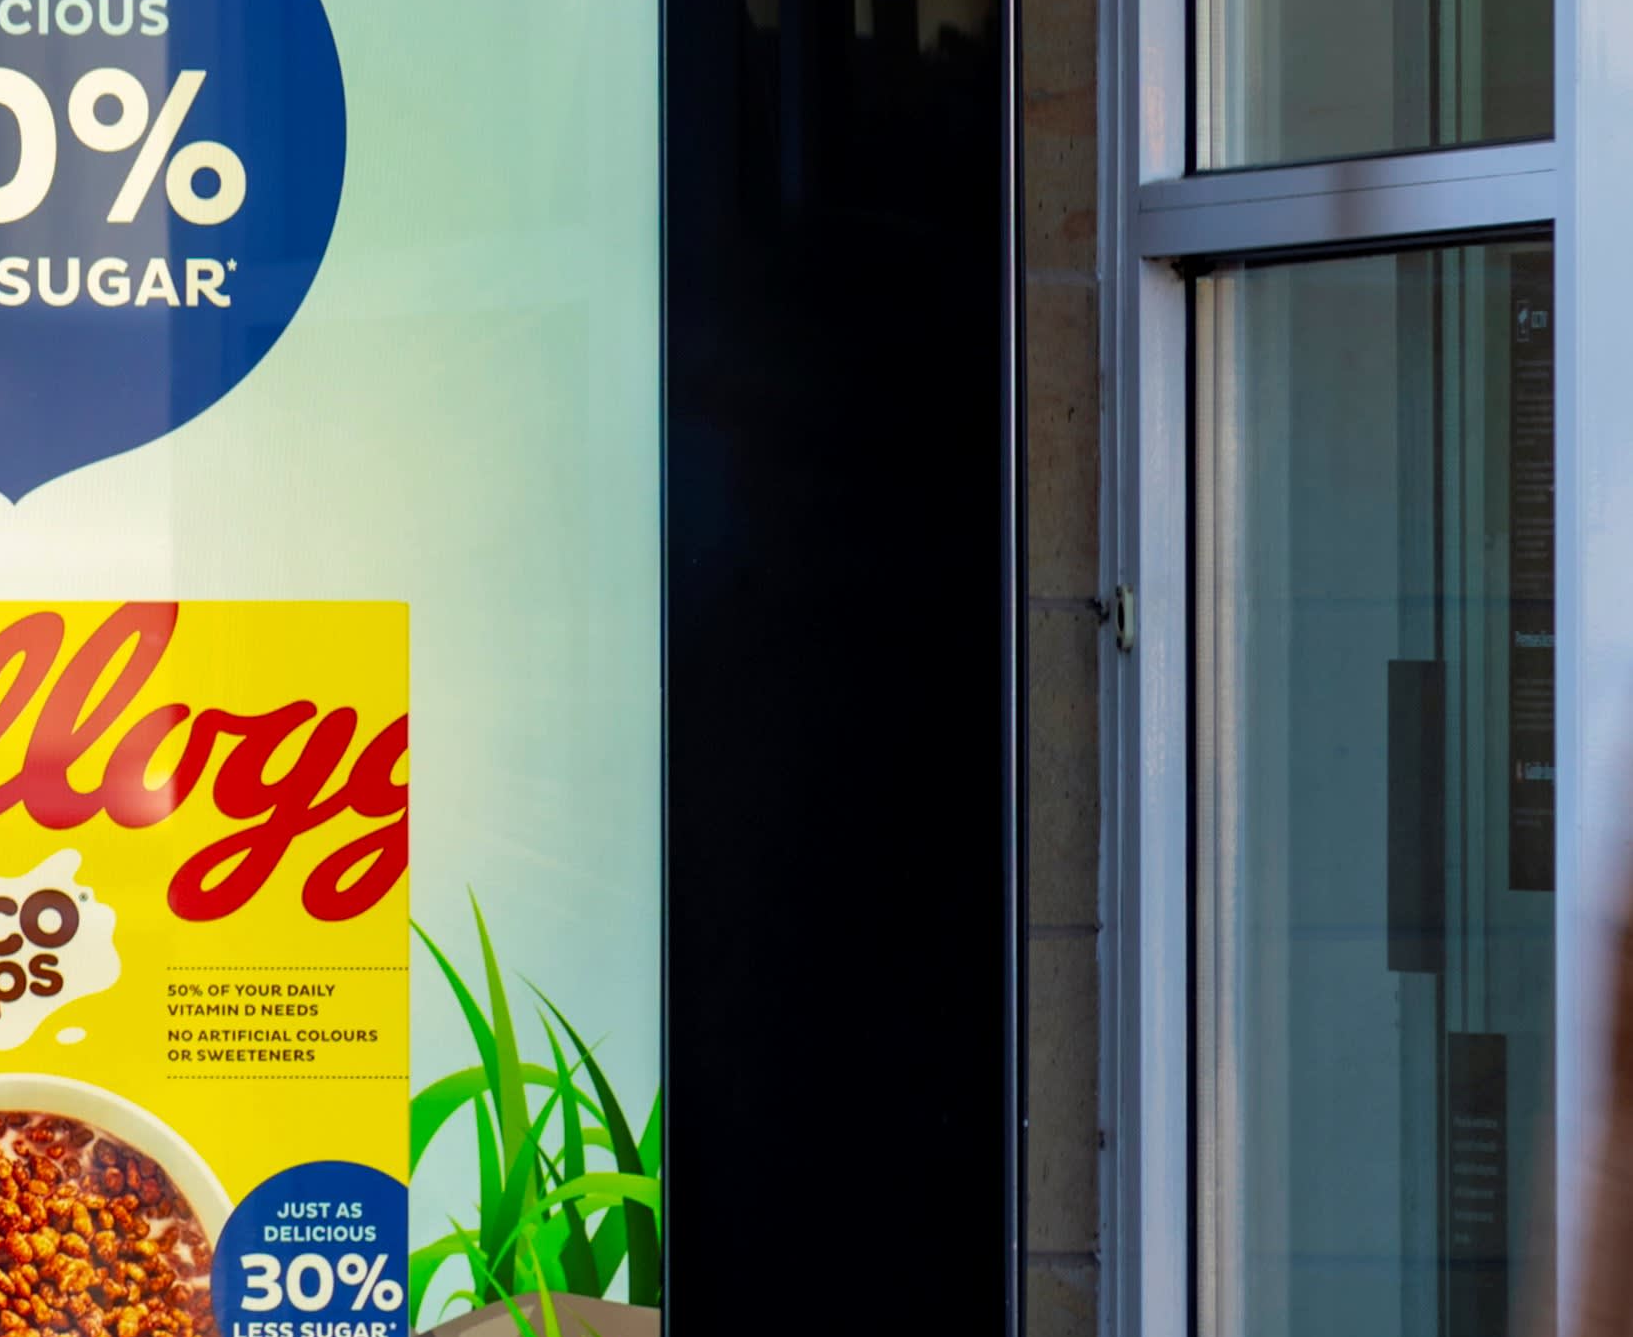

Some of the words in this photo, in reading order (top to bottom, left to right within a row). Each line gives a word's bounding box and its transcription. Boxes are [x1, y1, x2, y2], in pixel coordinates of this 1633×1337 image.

[167, 984, 203, 997] 50%
[207, 984, 230, 997] OF
[235, 984, 282, 997] YOUR
[287, 984, 336, 997] DAILY
[167, 1004, 239, 1016] VITAMIN
[245, 1004, 256, 1016] D
[261, 1004, 319, 1017] NEEDS
[167, 1029, 193, 1042] NO
[198, 1029, 292, 1042] ARTIFICIAL
[296, 1029, 378, 1042] COLOURS
[167, 1049, 193, 1062] OR
[197, 1049, 316, 1062] SWEETENERS
[276, 1202, 332, 1219] JUST
[336, 1202, 363, 1219] AS
[264, 1225, 376, 1242] DELICIOUS
[240, 1253, 403, 1312] 30%
